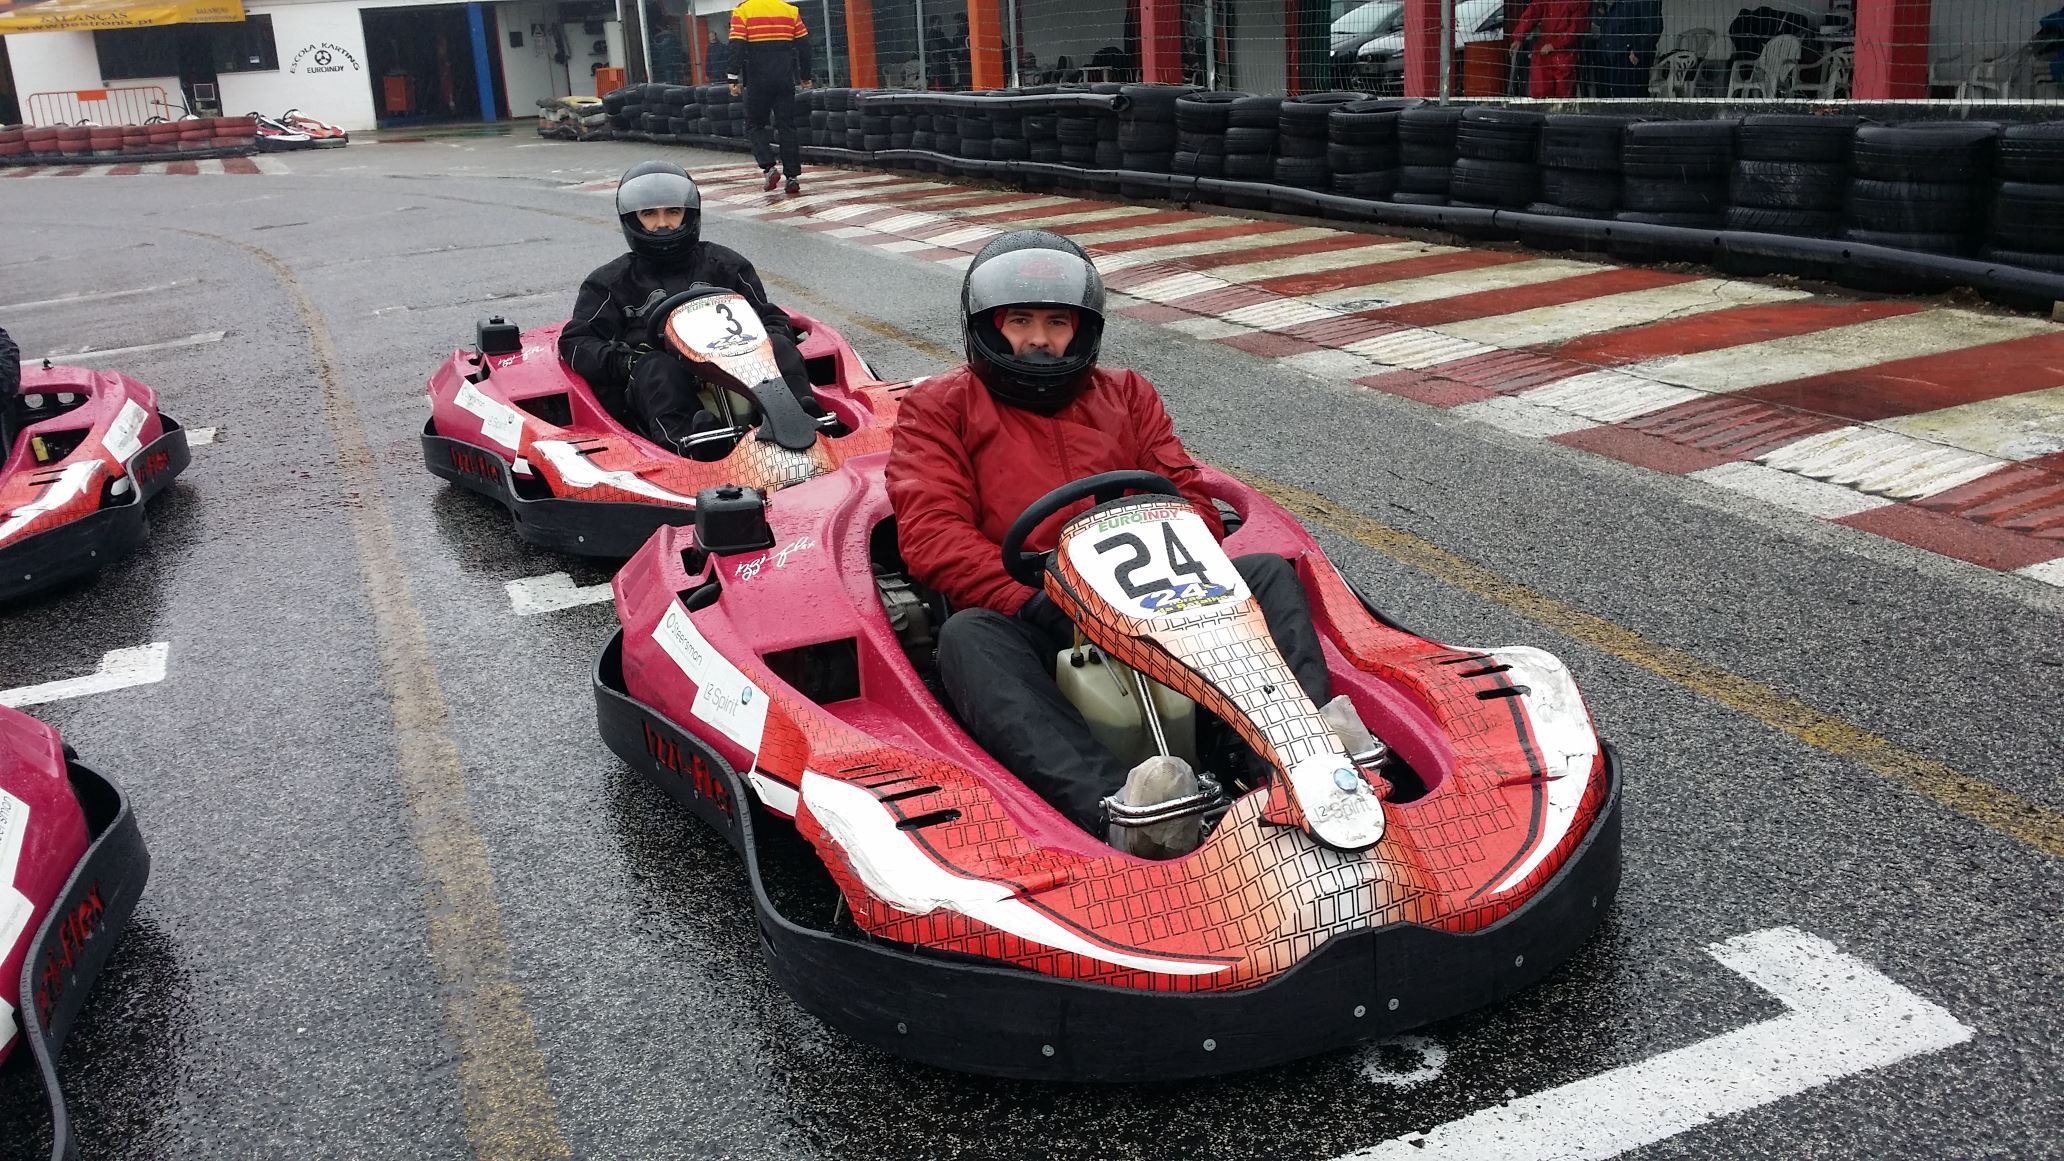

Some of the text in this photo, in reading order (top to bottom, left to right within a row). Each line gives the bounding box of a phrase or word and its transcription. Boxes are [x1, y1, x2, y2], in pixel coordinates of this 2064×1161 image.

[290, 42, 360, 74] ESCOLA KARTING
[307, 65, 344, 74] EUROINDY
[716, 303, 743, 336] 3
[1098, 509, 1180, 533] EUROINDY
[1094, 522, 1211, 600] 24
[1150, 583, 1208, 607] 24
